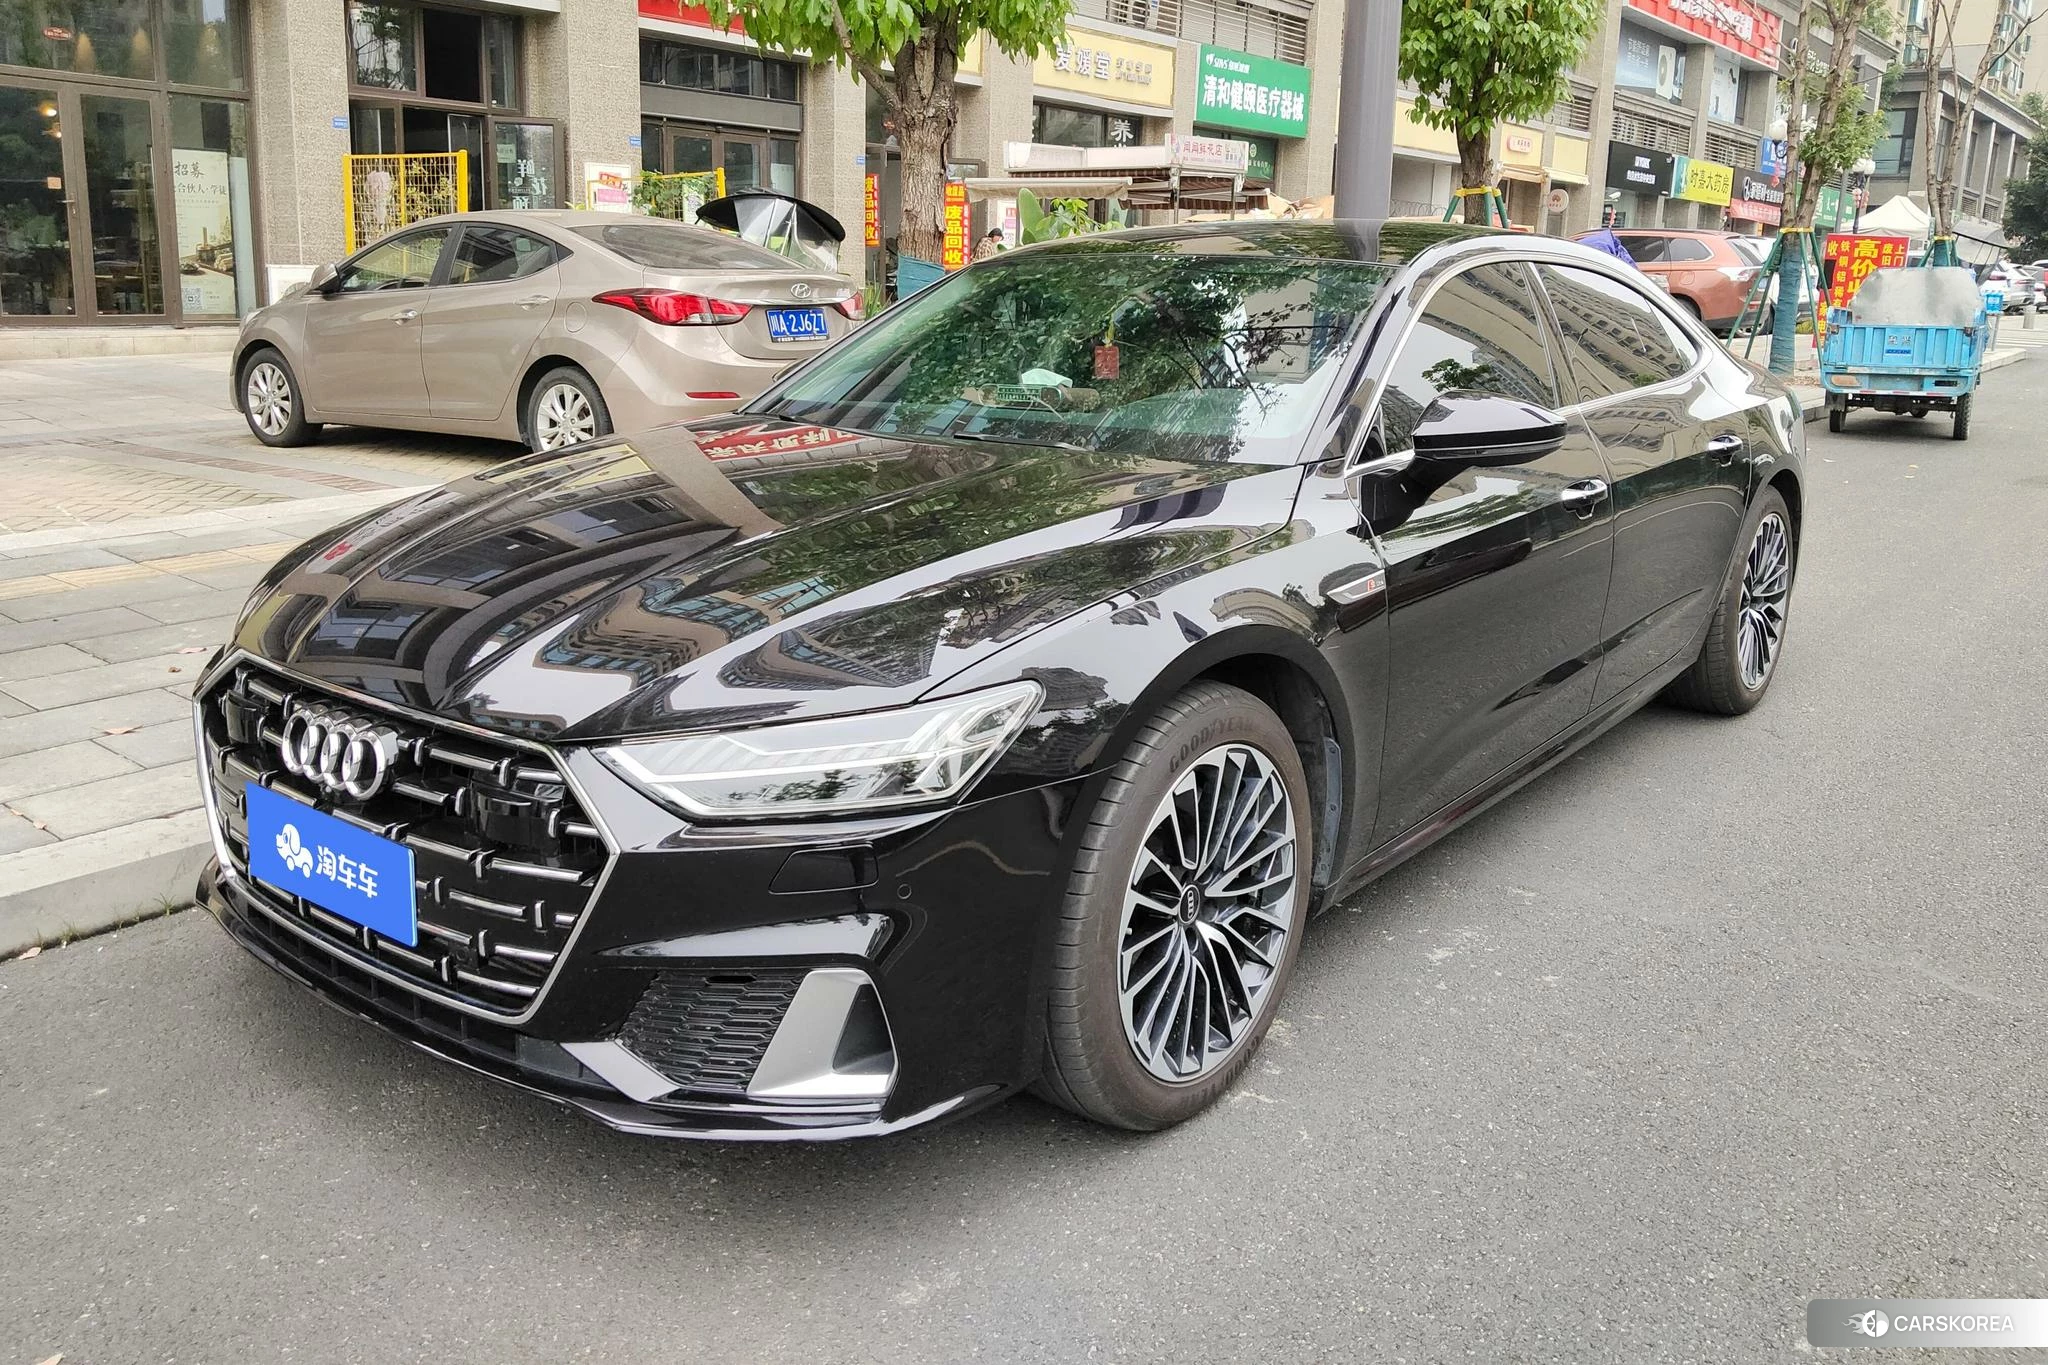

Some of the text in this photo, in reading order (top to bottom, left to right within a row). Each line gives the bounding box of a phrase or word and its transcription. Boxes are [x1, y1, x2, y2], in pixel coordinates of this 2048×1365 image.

[1202, 74, 1305, 122] 清和健颐医疗器械
[1110, 119, 1134, 148] 养
[174, 160, 206, 179] 招募
[173, 182, 227, 196] 合伙人·学徒
[944, 205, 964, 264] 废品回收
[1881, 243, 1895, 266] 废旧
[1893, 244, 1906, 266] 上门
